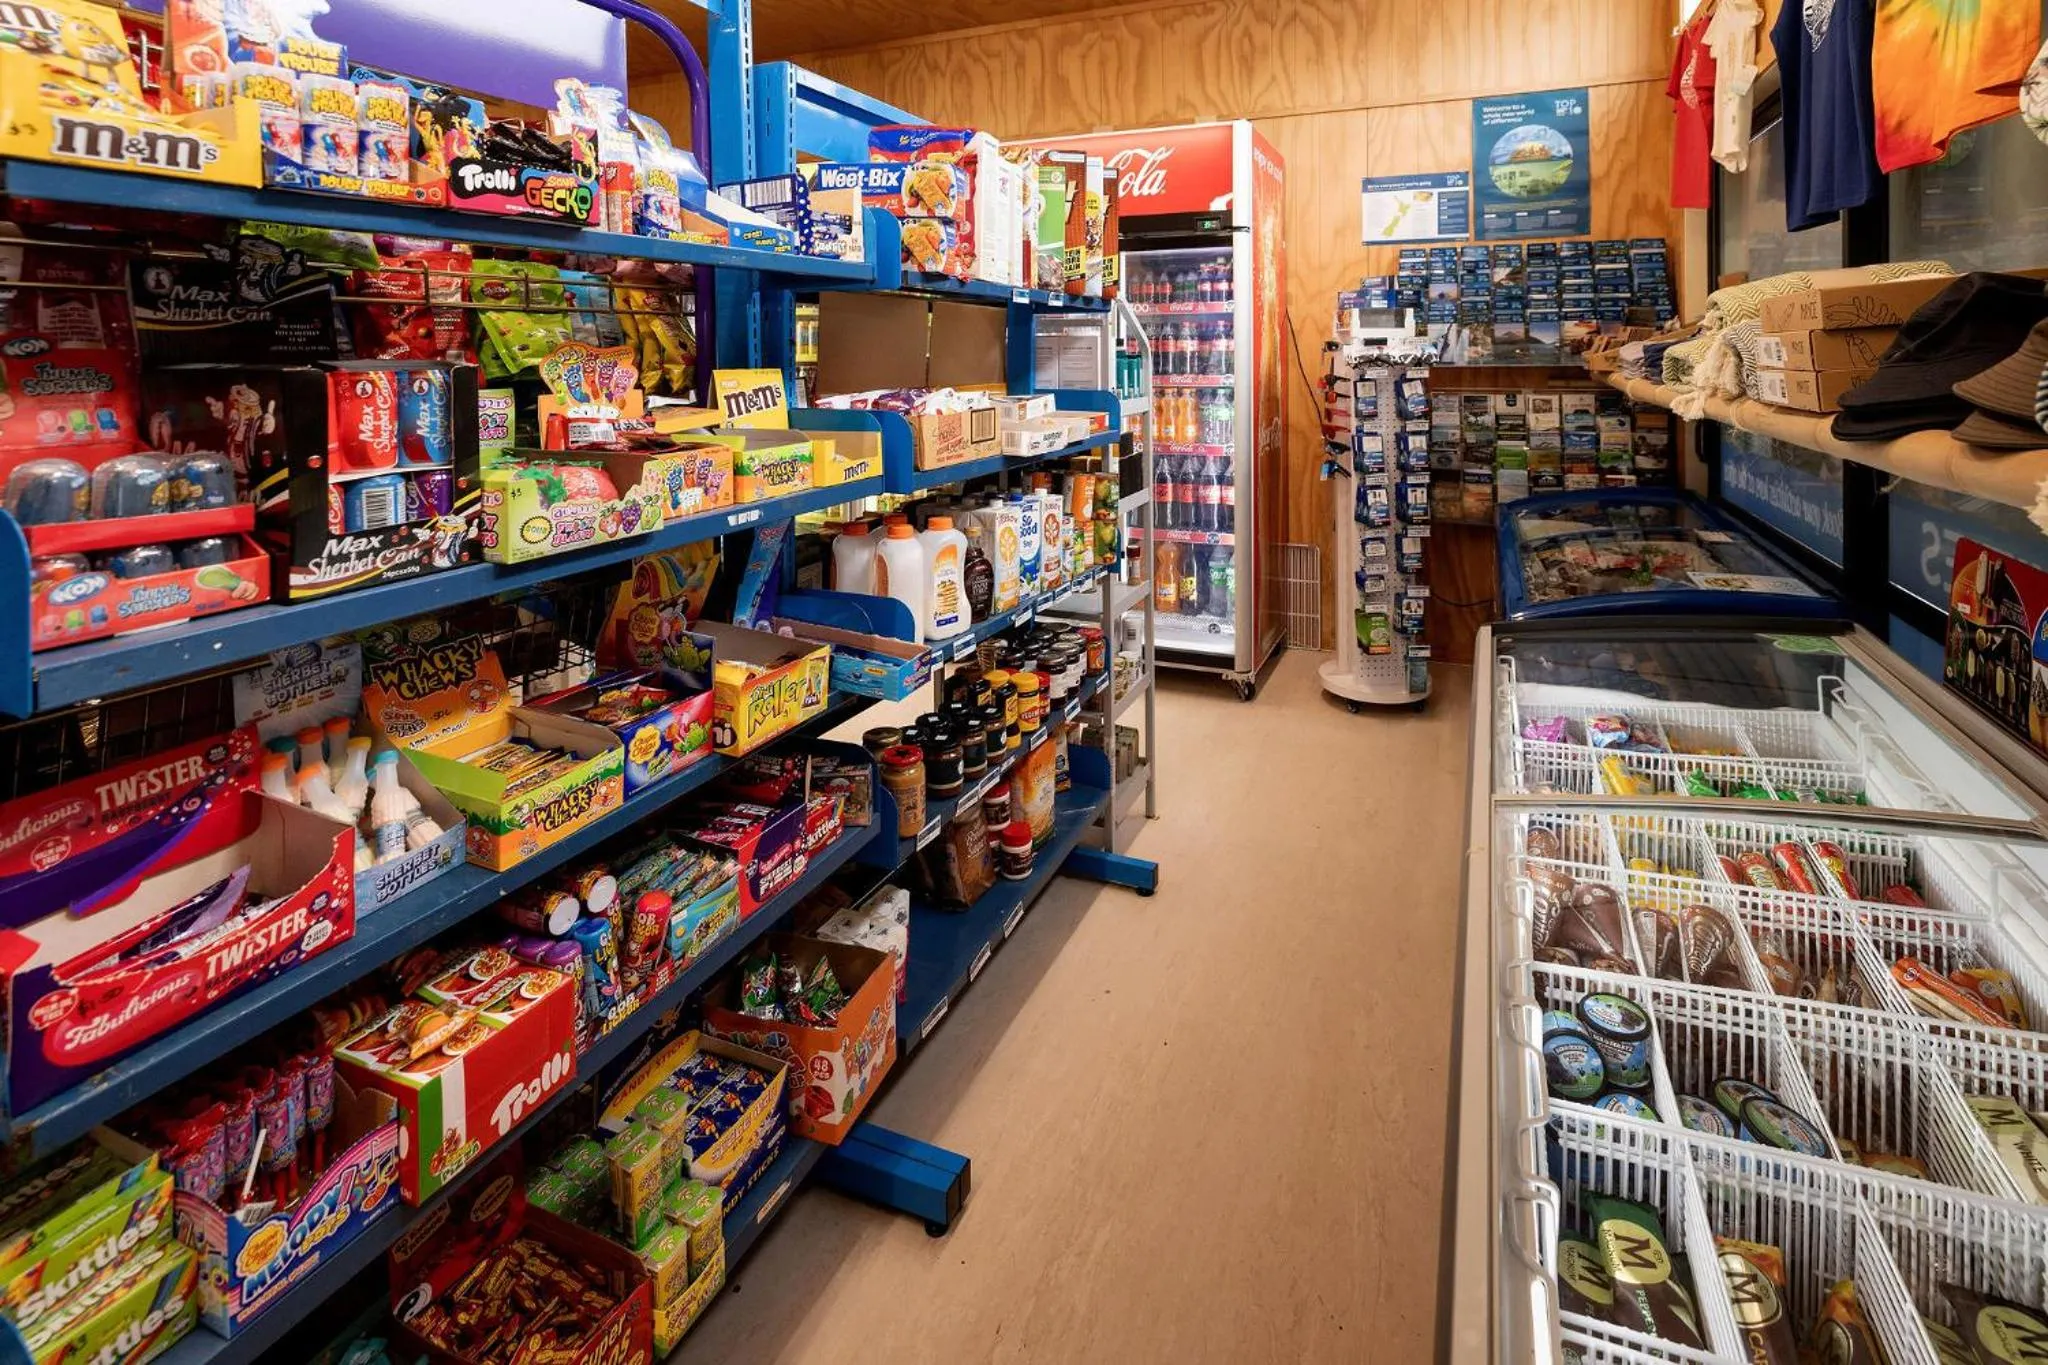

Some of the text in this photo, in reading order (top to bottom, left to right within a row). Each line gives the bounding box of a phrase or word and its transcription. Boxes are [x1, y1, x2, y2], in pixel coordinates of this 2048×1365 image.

[458, 164, 517, 192] Trolli
[821, 168, 900, 188] Weet-Bix
[525, 177, 592, 219] GECKO
[154, 299, 273, 323] Sherbet Can
[170, 285, 230, 302] Max
[416, 401, 431, 437] Max
[723, 385, 782, 418] m&m's
[359, 405, 374, 442] Max
[308, 544, 424, 581] Sherbet Can
[322, 535, 384, 557] Max
[377, 640, 480, 686] WHACKY
[400, 663, 474, 699] CHEWS
[534, 778, 599, 828] WHACKY
[543, 799, 592, 832] CHEWS
[807, 815, 841, 846] kittles
[376, 844, 441, 891] SHERBET
[376, 859, 439, 903] BOTTLES
[63, 973, 190, 1051] Fabulicious
[490, 1052, 571, 1135] Trolli
[611, 1069, 650, 1107] CANDY
[1978, 1107, 2025, 1126] M
[1613, 1232, 1658, 1269] M
[1578, 1250, 1612, 1291] M
[1726, 1271, 1764, 1304] M
